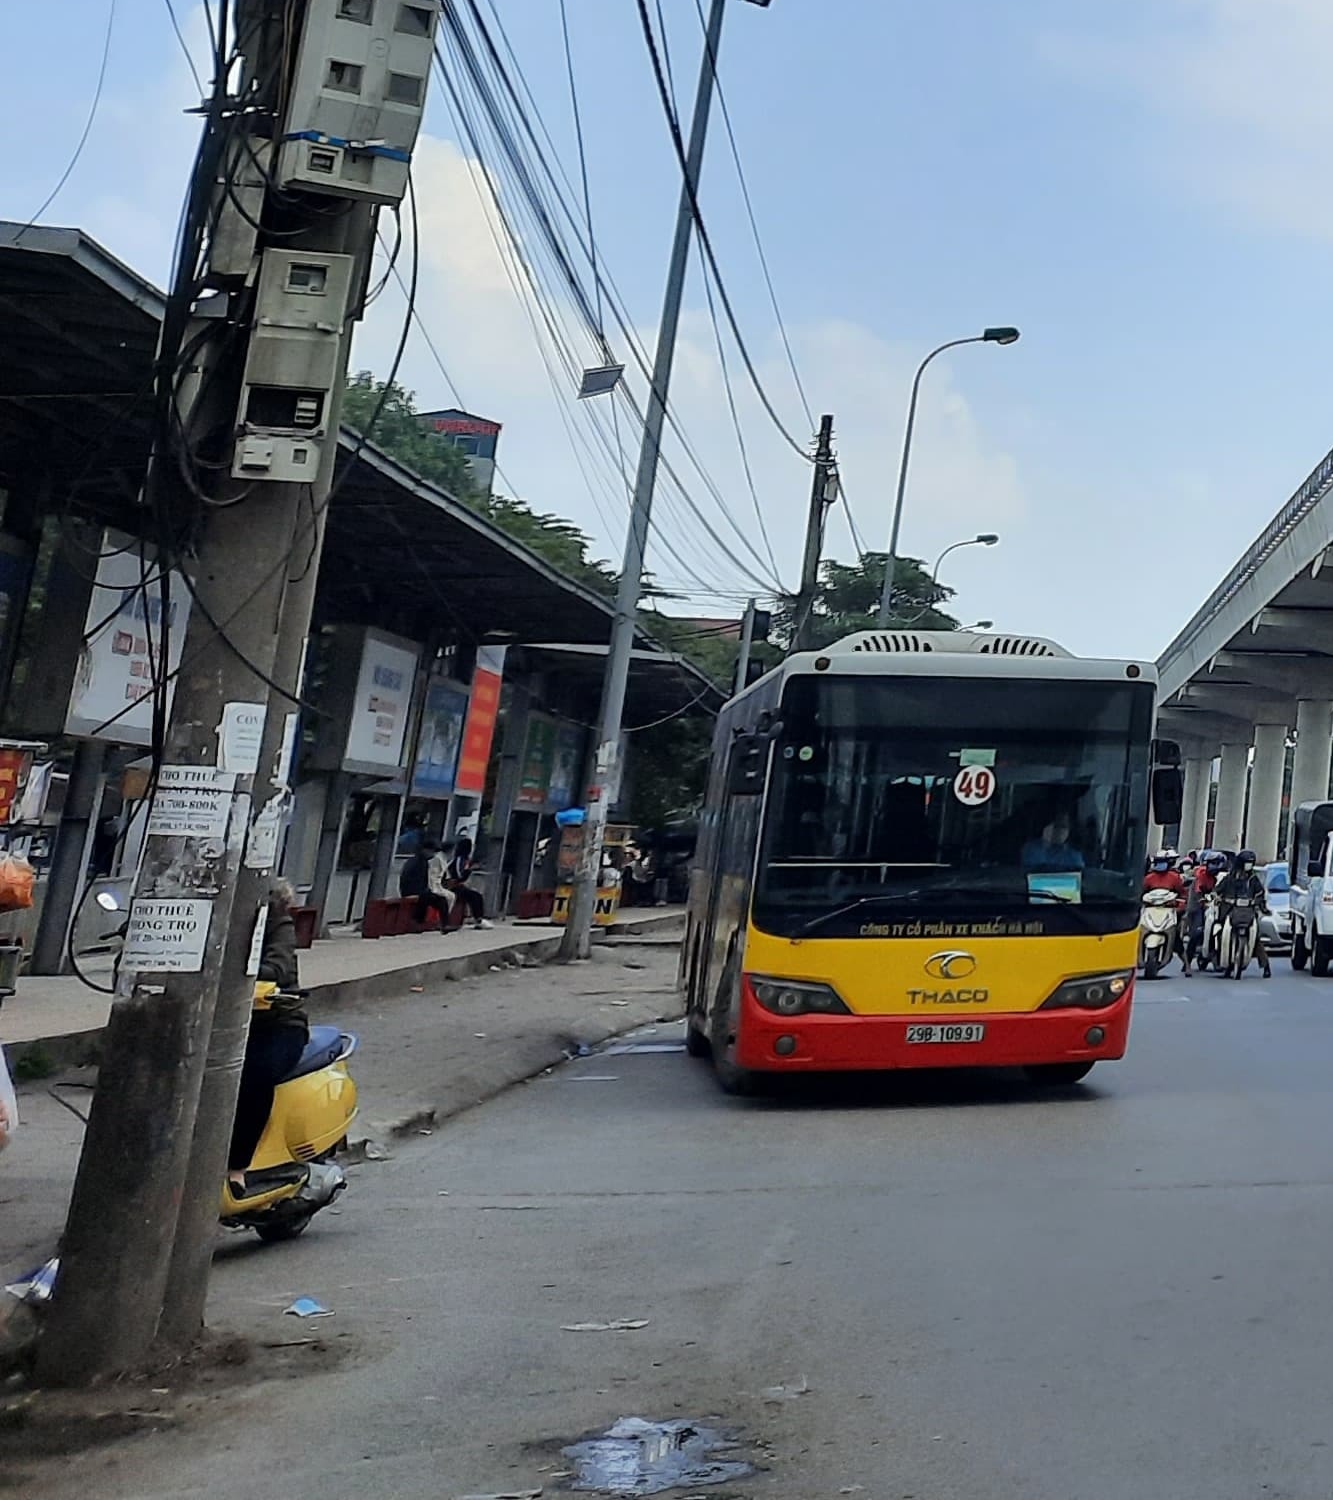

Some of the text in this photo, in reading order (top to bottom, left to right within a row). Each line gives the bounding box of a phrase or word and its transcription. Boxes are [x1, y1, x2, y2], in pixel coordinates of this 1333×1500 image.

[957, 771, 991, 799] 49
[167, 919, 197, 933] TRỌ
[860, 922, 890, 936] CÔNG
[893, 923, 904, 936] TY
[955, 924, 970, 935] XE
[906, 988, 990, 1005] THACO
